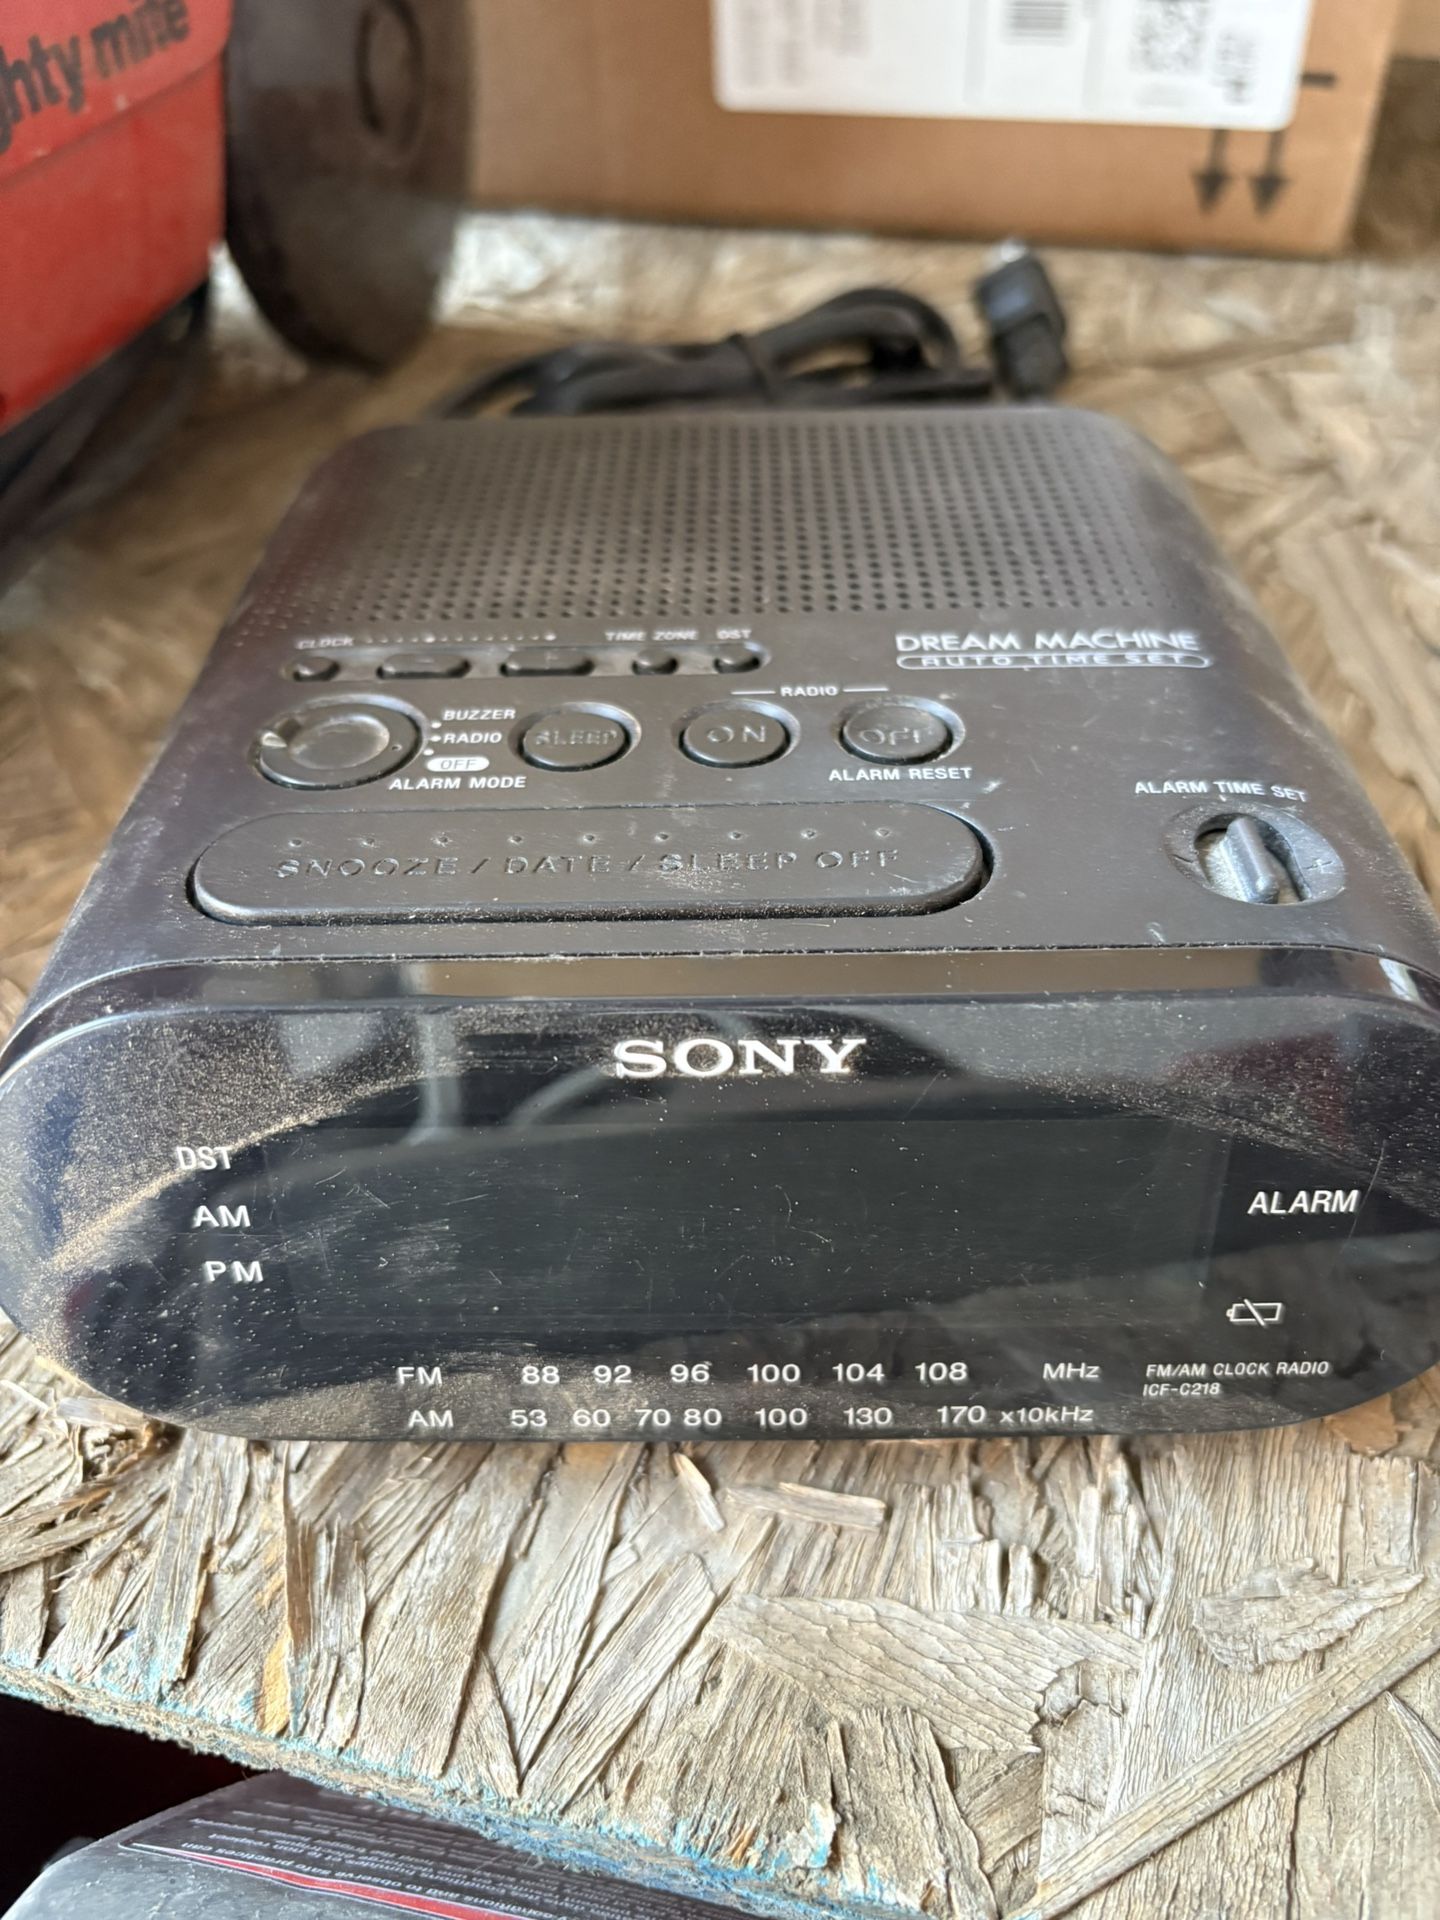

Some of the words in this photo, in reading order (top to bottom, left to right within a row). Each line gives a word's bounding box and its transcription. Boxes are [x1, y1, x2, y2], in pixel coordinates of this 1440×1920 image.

[605, 630, 645, 642] TIME
[652, 629, 698, 641] ZONE
[895, 633, 1021, 652] DREAM
[1034, 629, 1199, 651] MACHINE
[920, 655, 1012, 667] AUTO
[1030, 653, 1109, 666] TIME
[1126, 652, 1185, 665] SET
[780, 685, 839, 699] RADIO
[442, 709, 516, 721] BUZZER
[442, 732, 502, 745] RADIO
[534, 728, 619, 746] SLEEP
[705, 724, 768, 744] ON
[440, 759, 479, 771] OFF
[828, 767, 900, 782] ALARM
[908, 766, 972, 781] RESET
[388, 777, 462, 791] ALARM
[468, 776, 527, 790] MODE
[1134, 780, 1208, 794] ALARM
[1213, 780, 1266, 796] TIME
[1270, 784, 1307, 802] SET
[274, 857, 459, 880] SNOOZE
[503, 854, 612, 876] DATE
[659, 851, 798, 873] SLEEP
[816, 849, 900, 869] OFF
[614, 1037, 868, 1078] SONY
[175, 1145, 232, 1171] DST
[1246, 1189, 1360, 1215] ALARM
[191, 1204, 251, 1229] AM
[203, 1260, 264, 1283] PM
[397, 1366, 443, 1385] FM
[521, 1365, 560, 1384] 88
[593, 1364, 632, 1384] 92
[669, 1363, 709, 1383] 96
[747, 1362, 800, 1383] 100
[832, 1362, 885, 1382] 104
[914, 1362, 967, 1381] 108
[1042, 1362, 1100, 1380] MHz
[1145, 1363, 1206, 1378] FM/AM
[1212, 1362, 1269, 1376] CLOCK
[1275, 1360, 1329, 1375] RADIO
[1143, 1382, 1220, 1397] ICF-C218
[408, 1409, 454, 1428] AM
[510, 1409, 548, 1428] 53
[573, 1409, 612, 1428] 60
[635, 1408, 672, 1427] 70
[683, 1408, 723, 1428] 80
[755, 1407, 808, 1427] 100
[844, 1407, 893, 1427] 130
[937, 1405, 987, 1425] 170
[999, 1406, 1094, 1424] x10kHz
